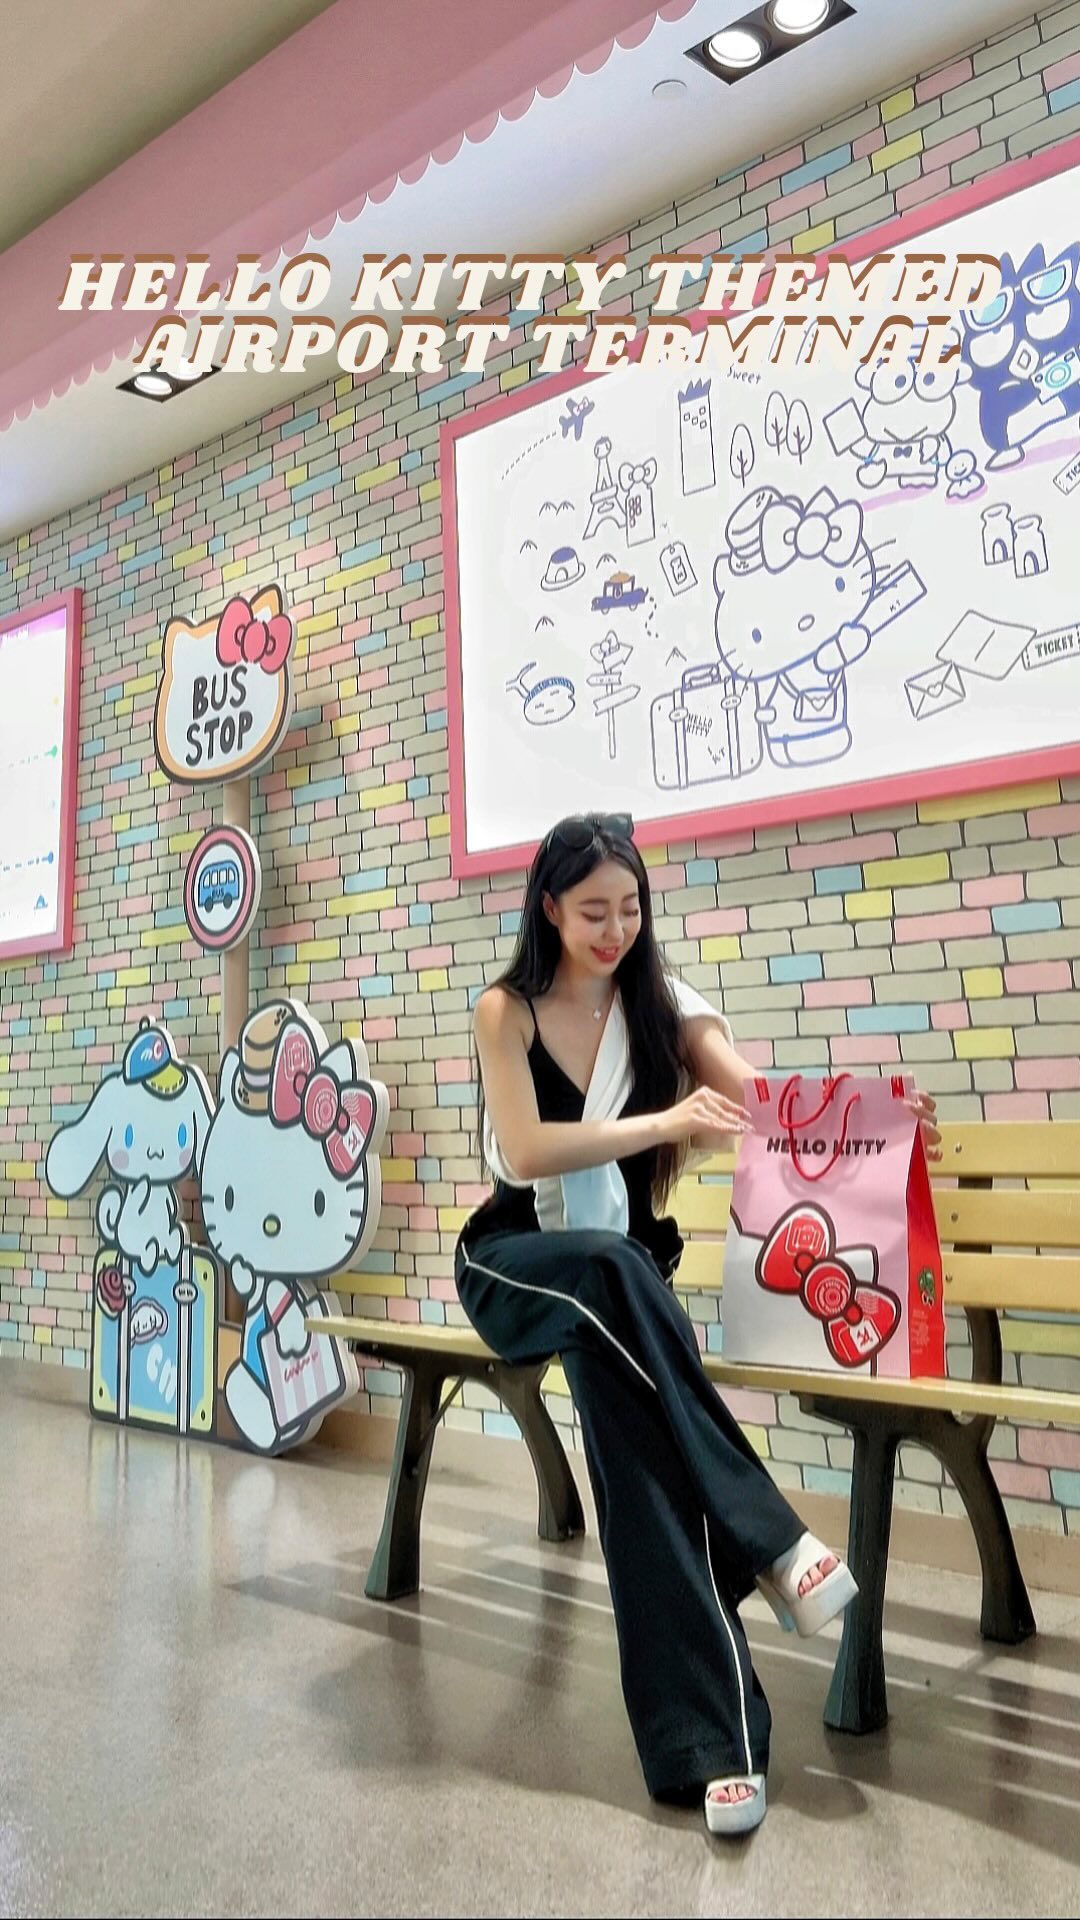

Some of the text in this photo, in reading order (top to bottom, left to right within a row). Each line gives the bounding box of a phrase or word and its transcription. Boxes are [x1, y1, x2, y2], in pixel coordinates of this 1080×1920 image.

[1034, 633, 1074, 659] TICKET
[192, 664, 248, 721] BUS
[686, 723, 711, 738] KITTY
[687, 713, 713, 730] HELLO
[185, 710, 254, 767] STOP
[767, 1137, 887, 1156] HELLO KITTY
